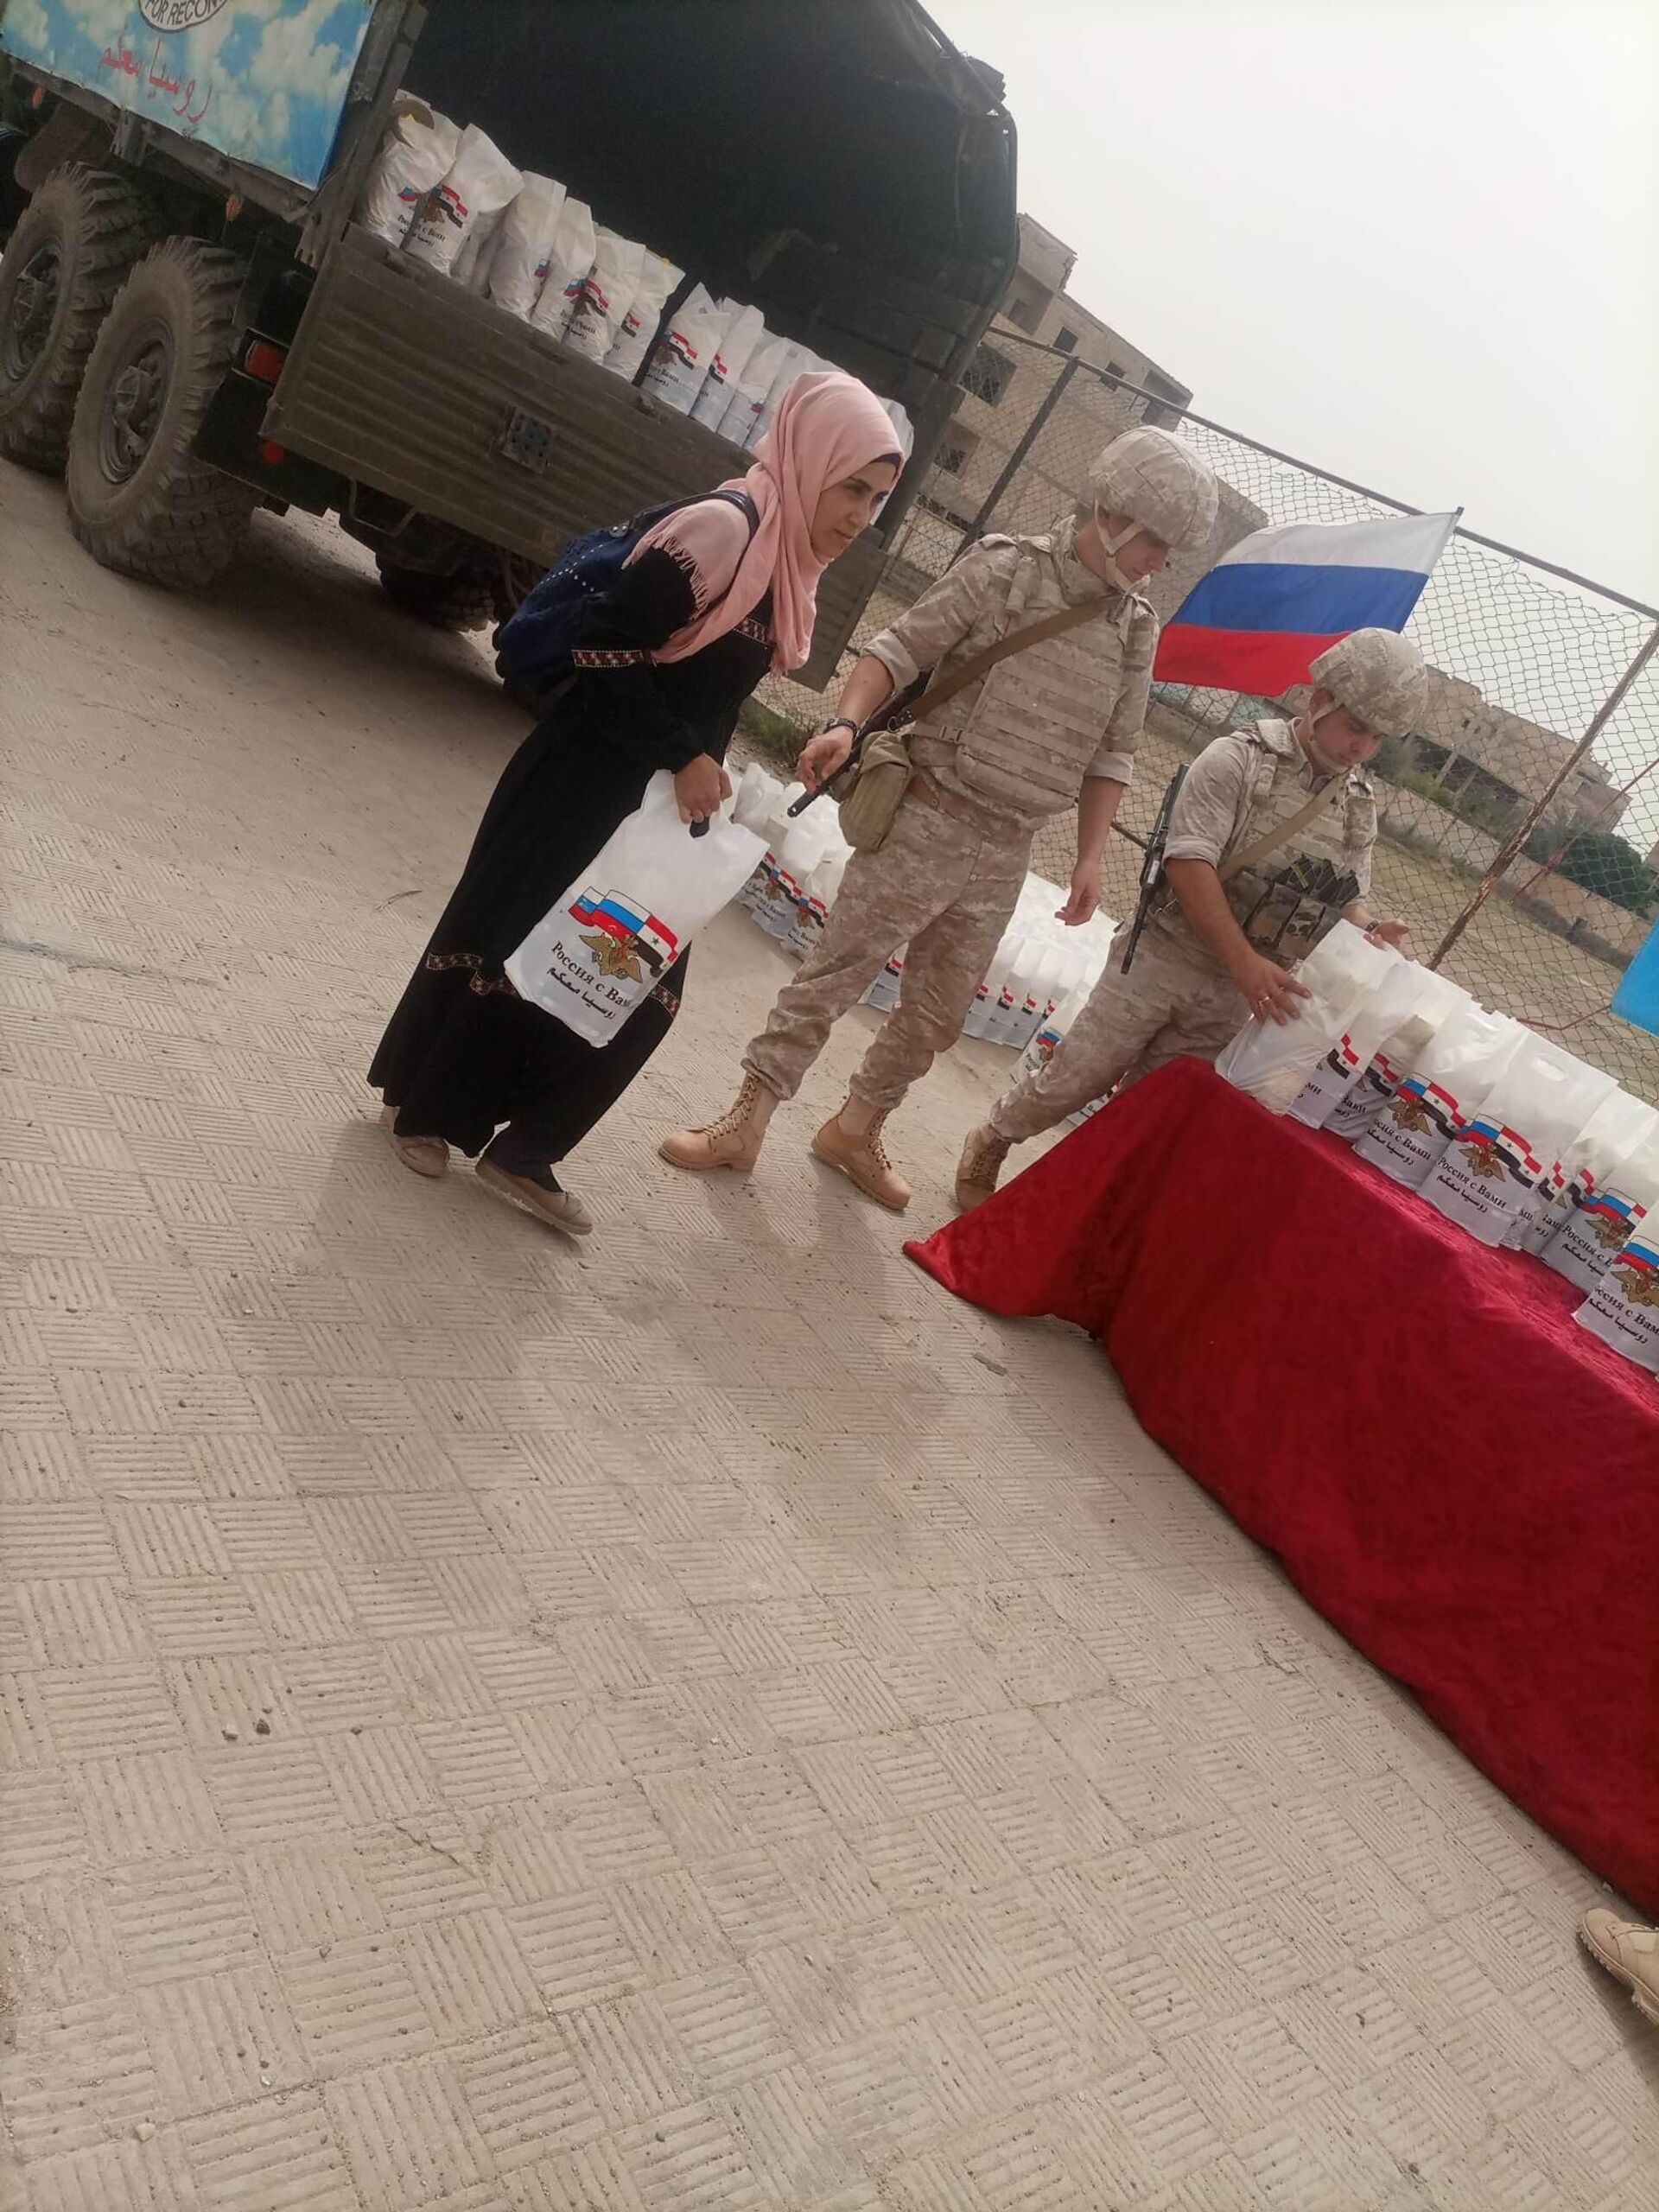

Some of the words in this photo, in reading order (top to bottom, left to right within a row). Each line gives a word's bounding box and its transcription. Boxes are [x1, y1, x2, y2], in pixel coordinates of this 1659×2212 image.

[551, 940, 595, 986] Россия
[594, 982, 606, 992] с
[1402, 1137, 1432, 1160] Вами
[1438, 1156, 1471, 1185] Россия
[1470, 1180, 1478, 1190] с
[1477, 1185, 1507, 1210] Вами
[1562, 1225, 1597, 1255] Россия
[1624, 1309, 1634, 1318] с
[1633, 1313, 1659, 1338] Вам
